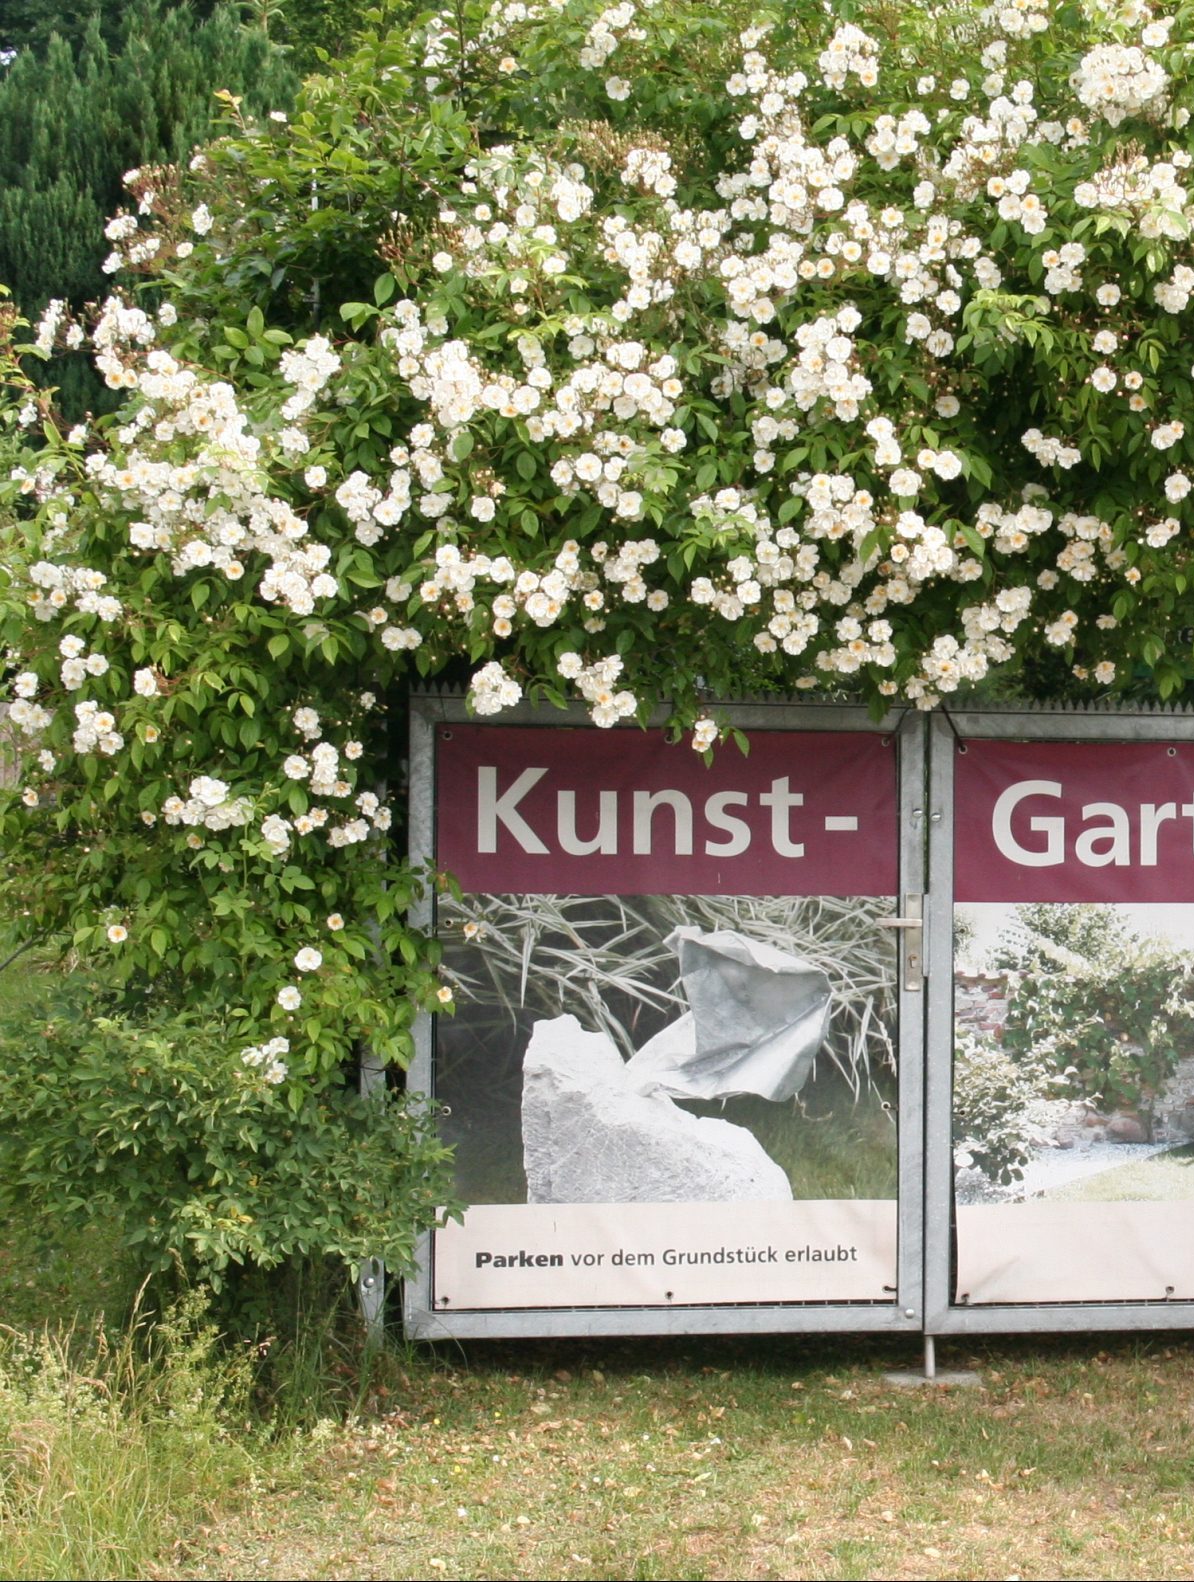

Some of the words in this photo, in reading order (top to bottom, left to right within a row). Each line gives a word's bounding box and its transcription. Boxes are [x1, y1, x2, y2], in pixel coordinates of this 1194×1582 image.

[475, 1250, 564, 1268] Parken
[571, 1251, 604, 1267] vor
[611, 1248, 655, 1266] dem
[662, 1245, 778, 1265] Grundstück
[784, 1244, 858, 1263] erlaubt
